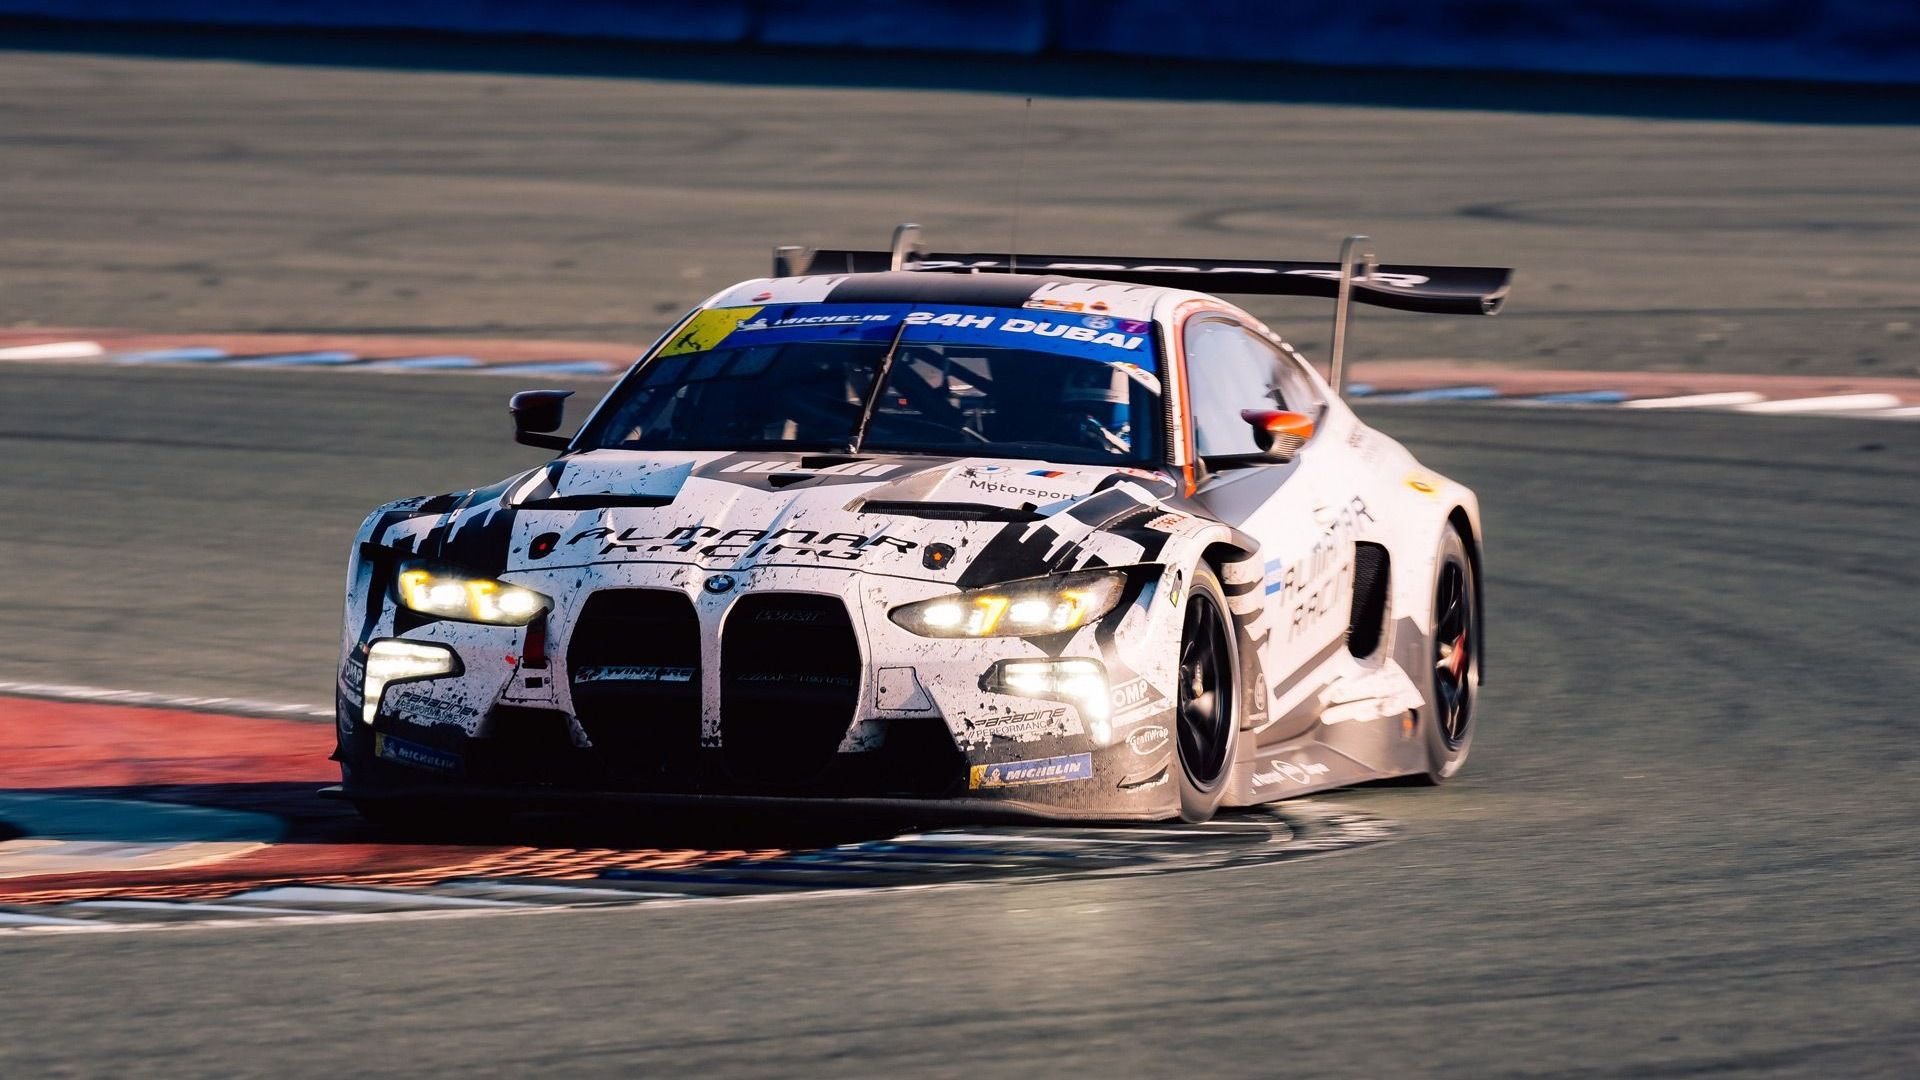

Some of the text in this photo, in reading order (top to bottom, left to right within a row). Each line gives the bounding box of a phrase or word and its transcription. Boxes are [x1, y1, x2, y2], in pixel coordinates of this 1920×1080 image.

[903, 311, 1144, 350] 24H DUBAI
[1124, 320, 1145, 333] 7
[968, 479, 1079, 502] Motorsport
[566, 527, 919, 555] ALMANAR
[346, 663, 363, 686] OMP
[1114, 678, 1148, 707] OMP
[976, 717, 1054, 738] PERFORMANC
[1006, 762, 1081, 781] MICHELIN
